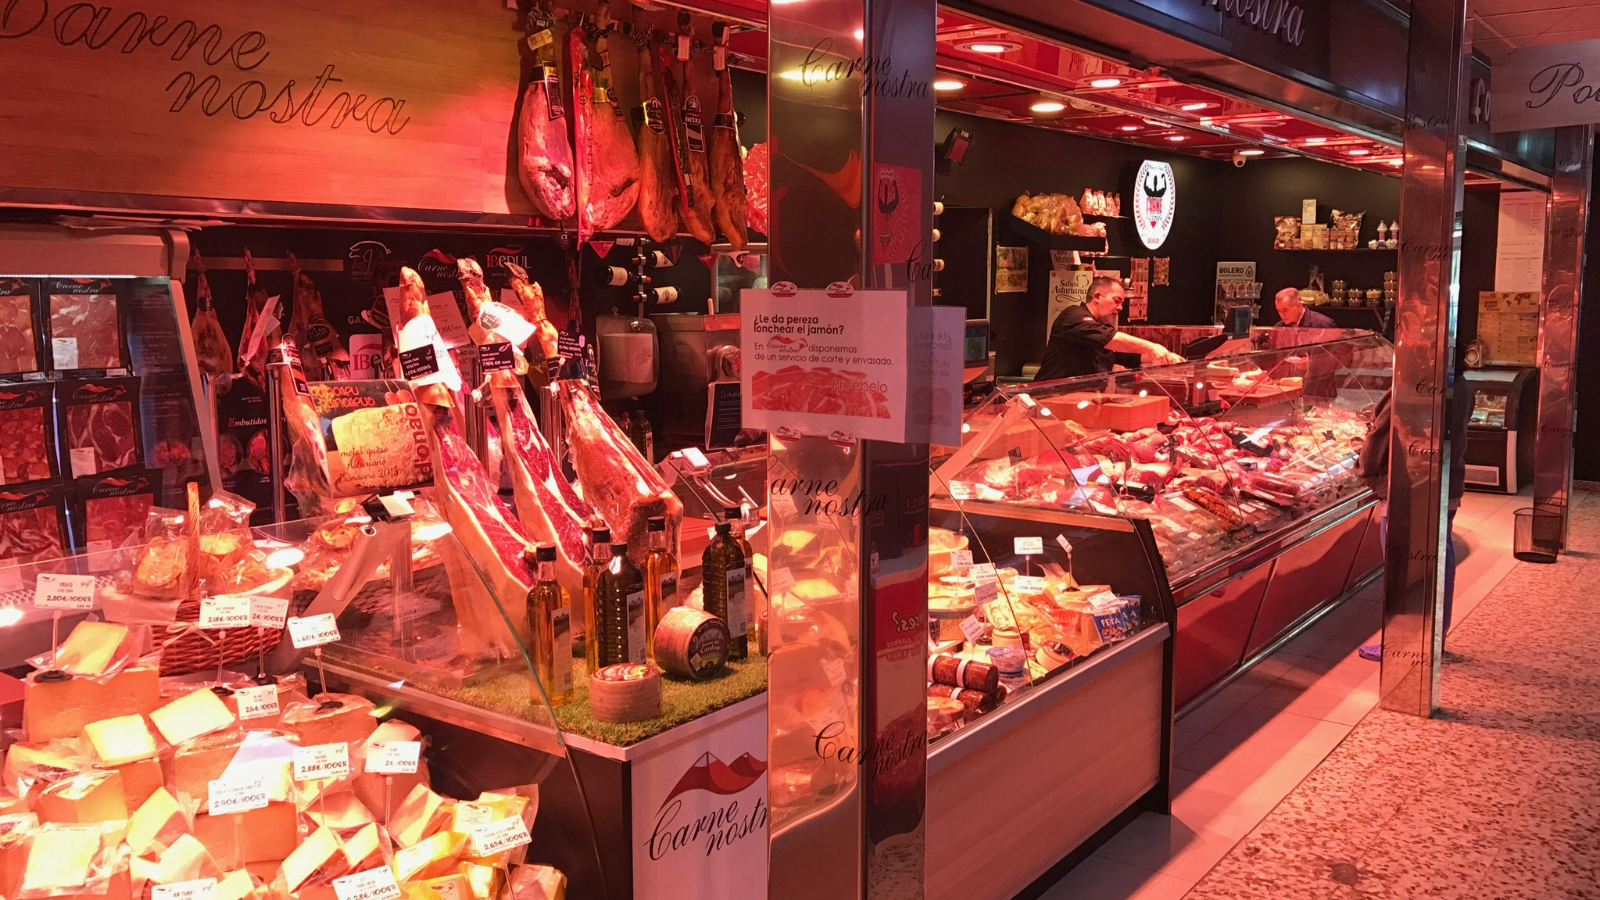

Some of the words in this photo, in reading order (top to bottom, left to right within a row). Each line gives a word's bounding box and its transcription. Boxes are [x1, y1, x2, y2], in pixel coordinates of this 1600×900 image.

[798, 37, 892, 91] Carne
[861, 69, 928, 99] nostra
[166, 65, 410, 135] nostra
[1219, 266, 1244, 274] BOLERO
[1060, 279, 1079, 287] Salsas
[754, 315, 769, 326] ¿Le
[772, 314, 784, 324] da
[787, 316, 819, 326] pereza
[753, 324, 795, 334] lonchear
[797, 324, 805, 334] el
[807, 324, 844, 336] jamón?
[754, 342, 763, 350] En
[808, 344, 858, 354] disponemos
[754, 352, 764, 361] de
[778, 353, 807, 362] servicio
[808, 354, 820, 362] de
[821, 355, 844, 363] corte
[845, 357, 850, 365] y
[852, 356, 894, 366] envasado.
[832, 378, 888, 393] Pruébelo
[228, 417, 267, 427] Embutidos
[366, 446, 388, 456] queso
[347, 458, 387, 469] Asturiano
[803, 489, 888, 518] nostra
[1101, 617, 1121, 627] FETA
[812, 721, 895, 766] Carne
[872, 729, 927, 781] nostra
[643, 800, 739, 861] Carne
